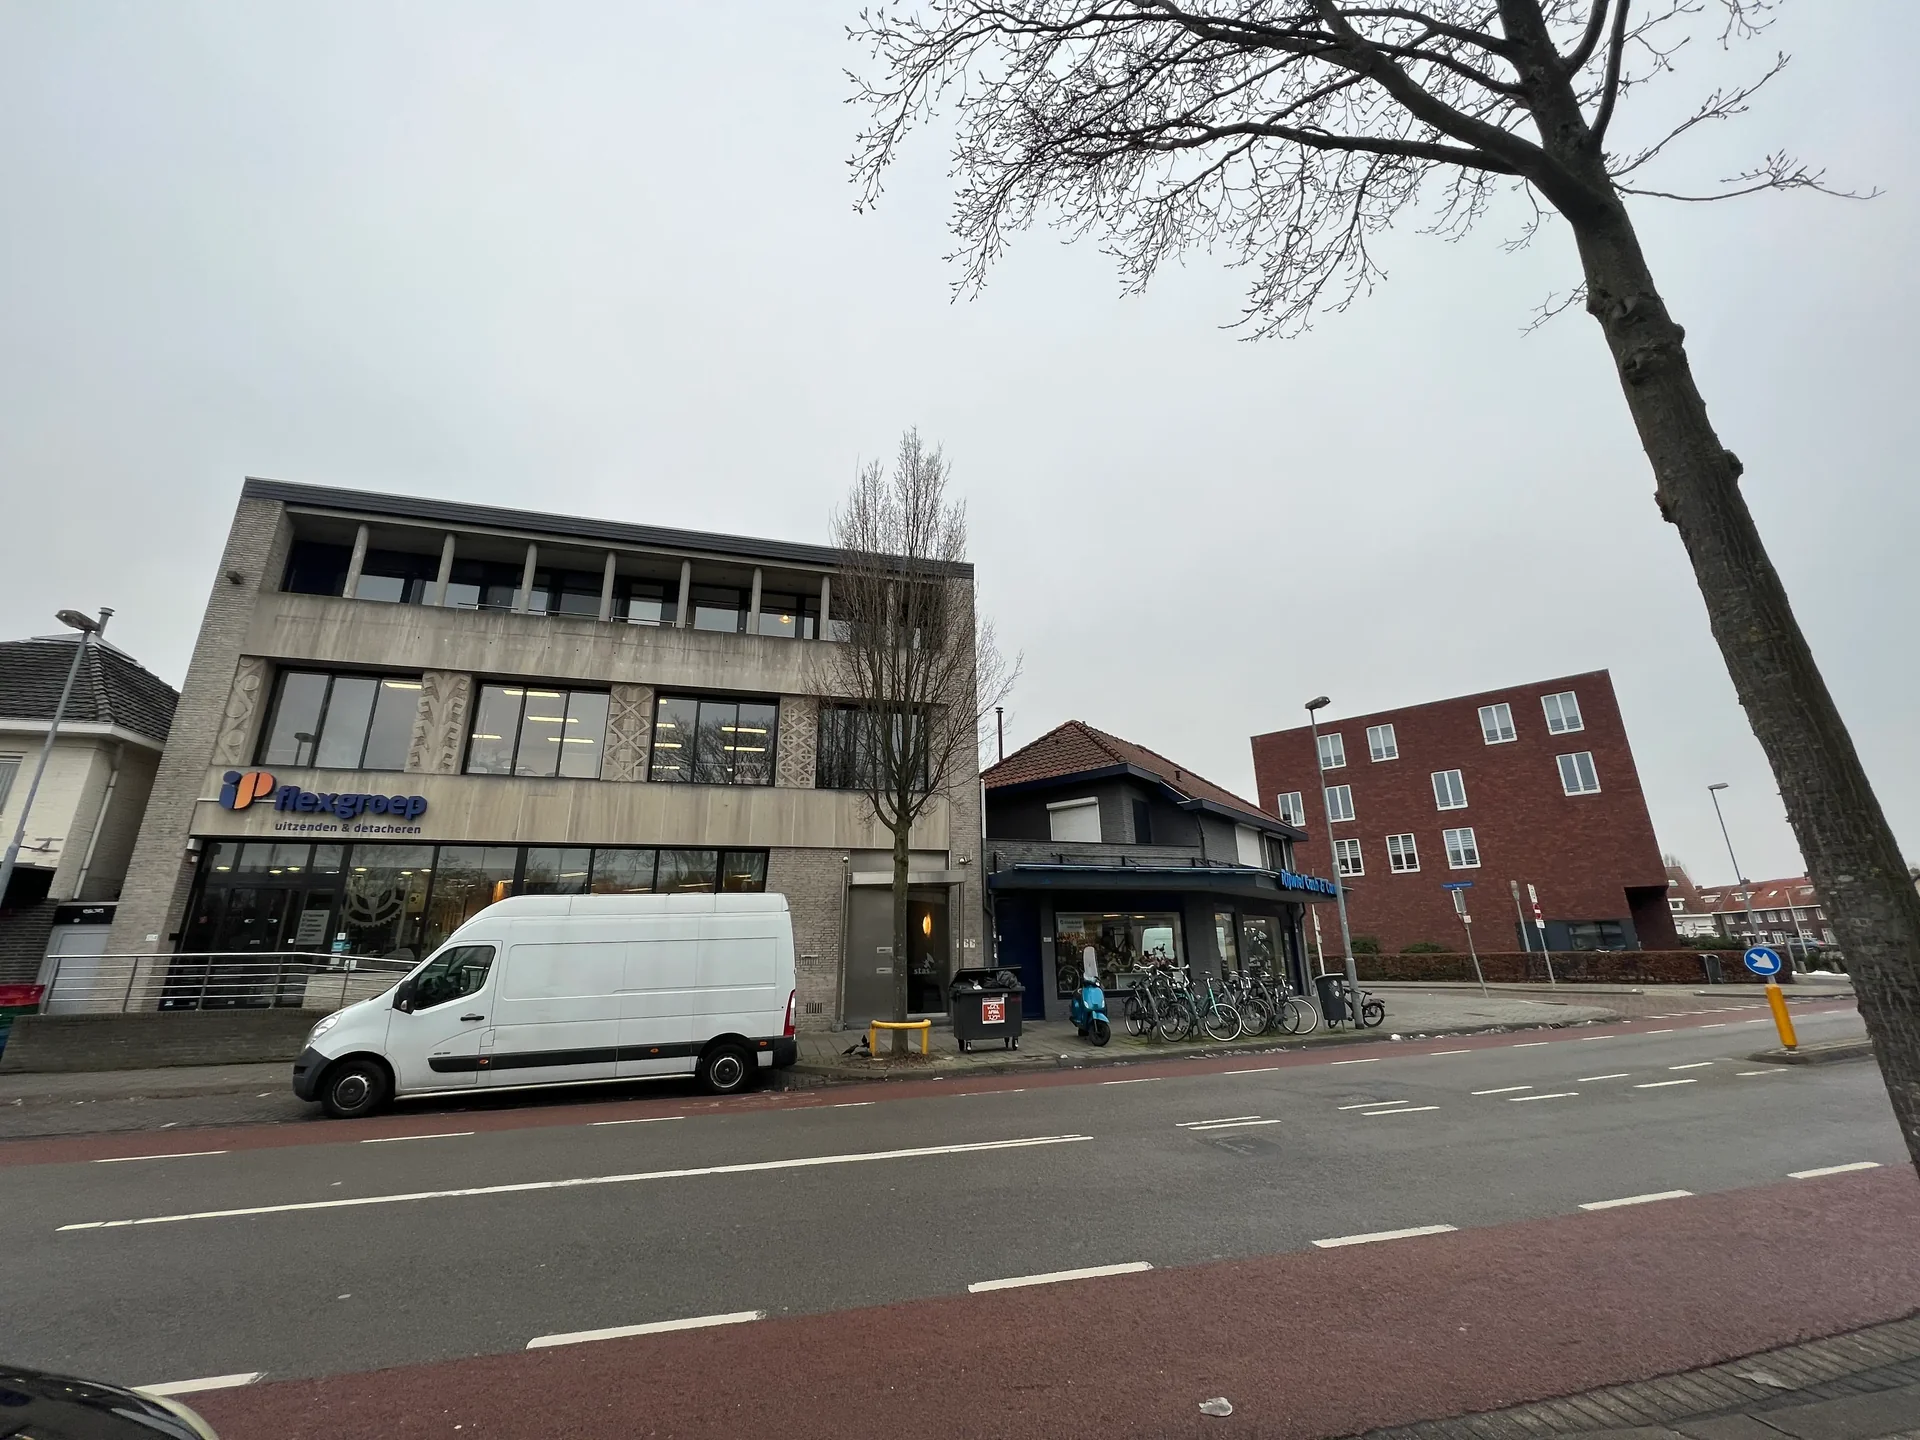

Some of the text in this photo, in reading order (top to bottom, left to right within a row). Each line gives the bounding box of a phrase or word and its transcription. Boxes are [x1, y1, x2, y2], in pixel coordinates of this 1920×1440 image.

[275, 786, 427, 820] flexgroep
[275, 821, 421, 834] uitzenden & detacheren
